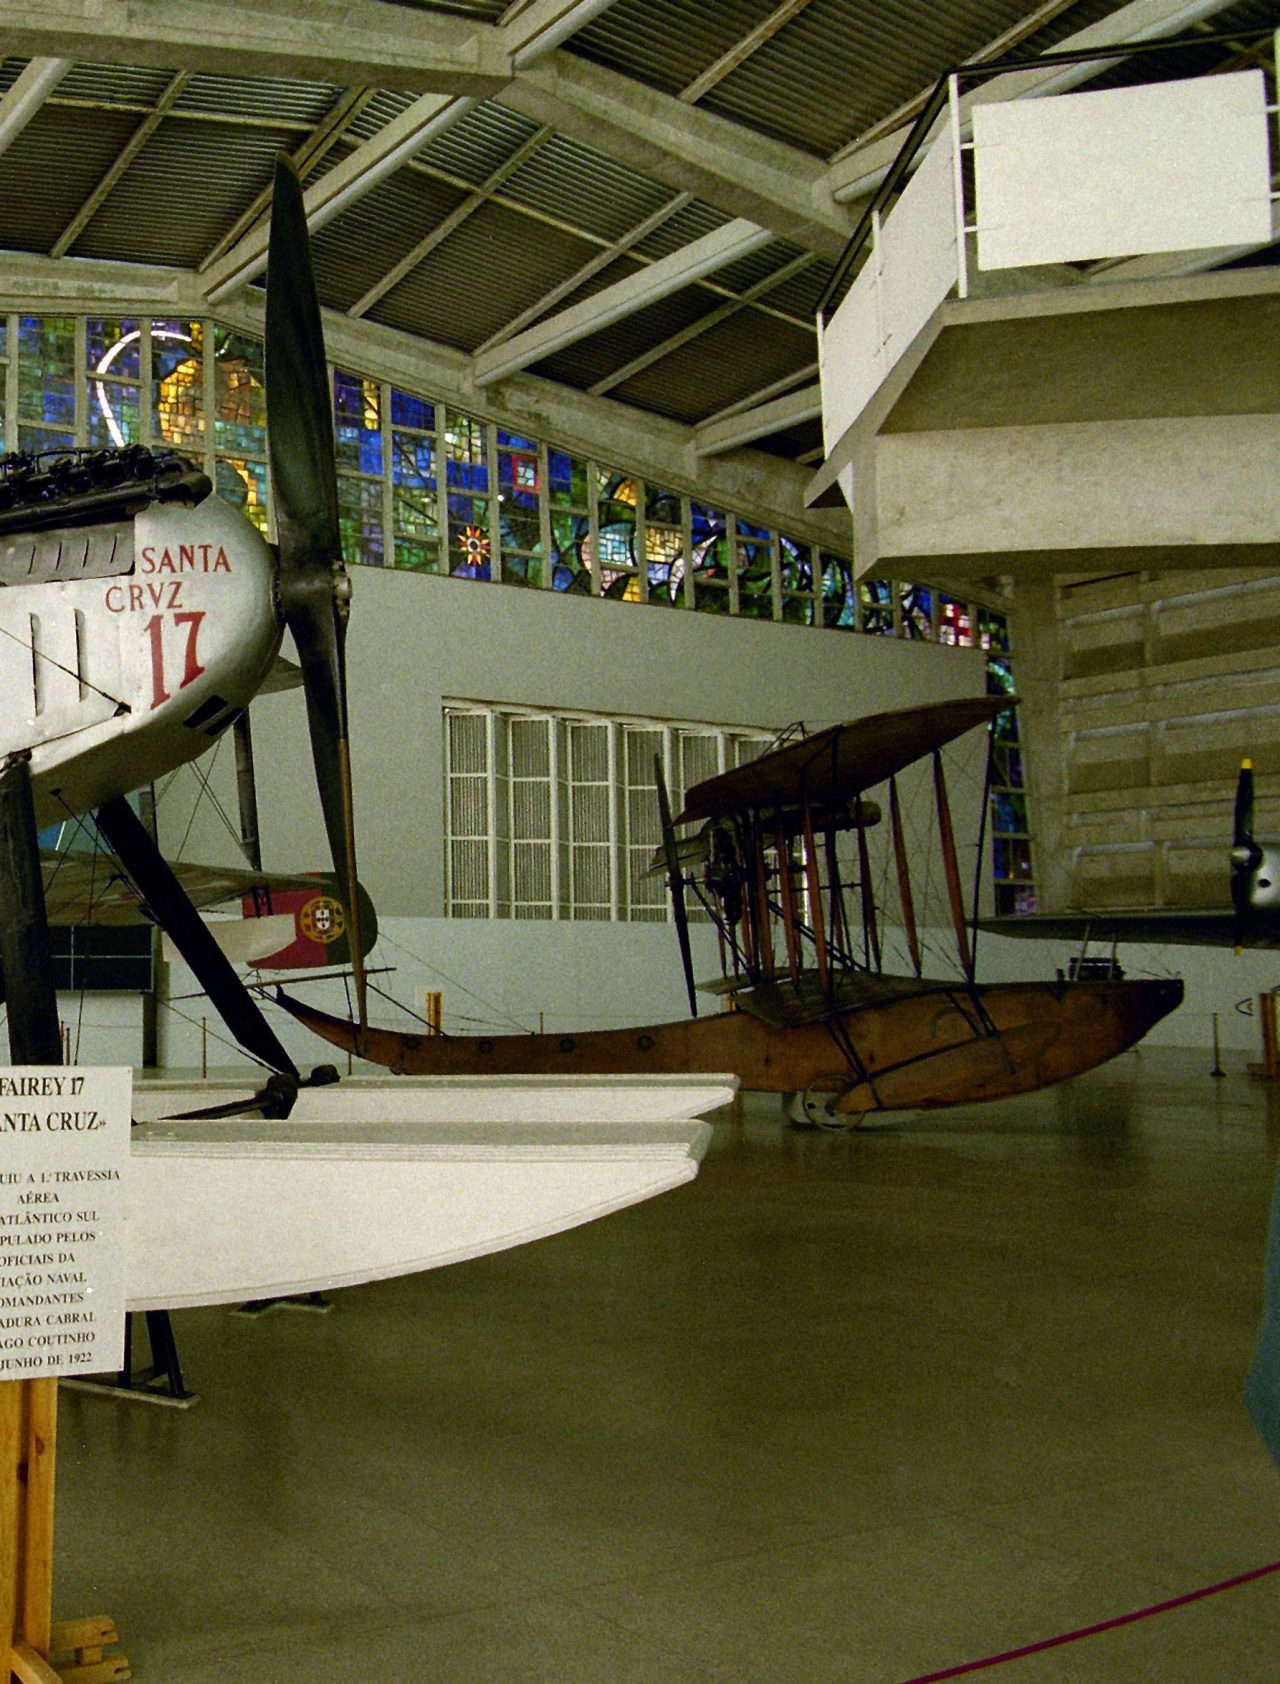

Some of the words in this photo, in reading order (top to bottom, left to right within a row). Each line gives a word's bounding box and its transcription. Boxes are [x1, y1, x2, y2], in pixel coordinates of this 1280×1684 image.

[141, 544, 232, 574] SANTA
[105, 581, 183, 613] CRVZ
[143, 611, 207, 710] 17
[71, 1076, 85, 1096] 17
[46, 1111, 106, 1131] CRUZ»
[27, 1174, 35, 1184] A
[54, 1170, 121, 1183] TRAVESSIA
[16, 1190, 60, 1205] AÉREA
[76, 1211, 100, 1222] SUL
[56, 1231, 96, 1243] PELOS
[58, 1252, 75, 1263] DA
[46, 1272, 87, 1285] NAVAL
[46, 1312, 96, 1326] CABRAL
[27, 1332, 96, 1347] COUTINHO
[47, 1354, 64, 1366] DE
[69, 1352, 93, 1364] 1922
